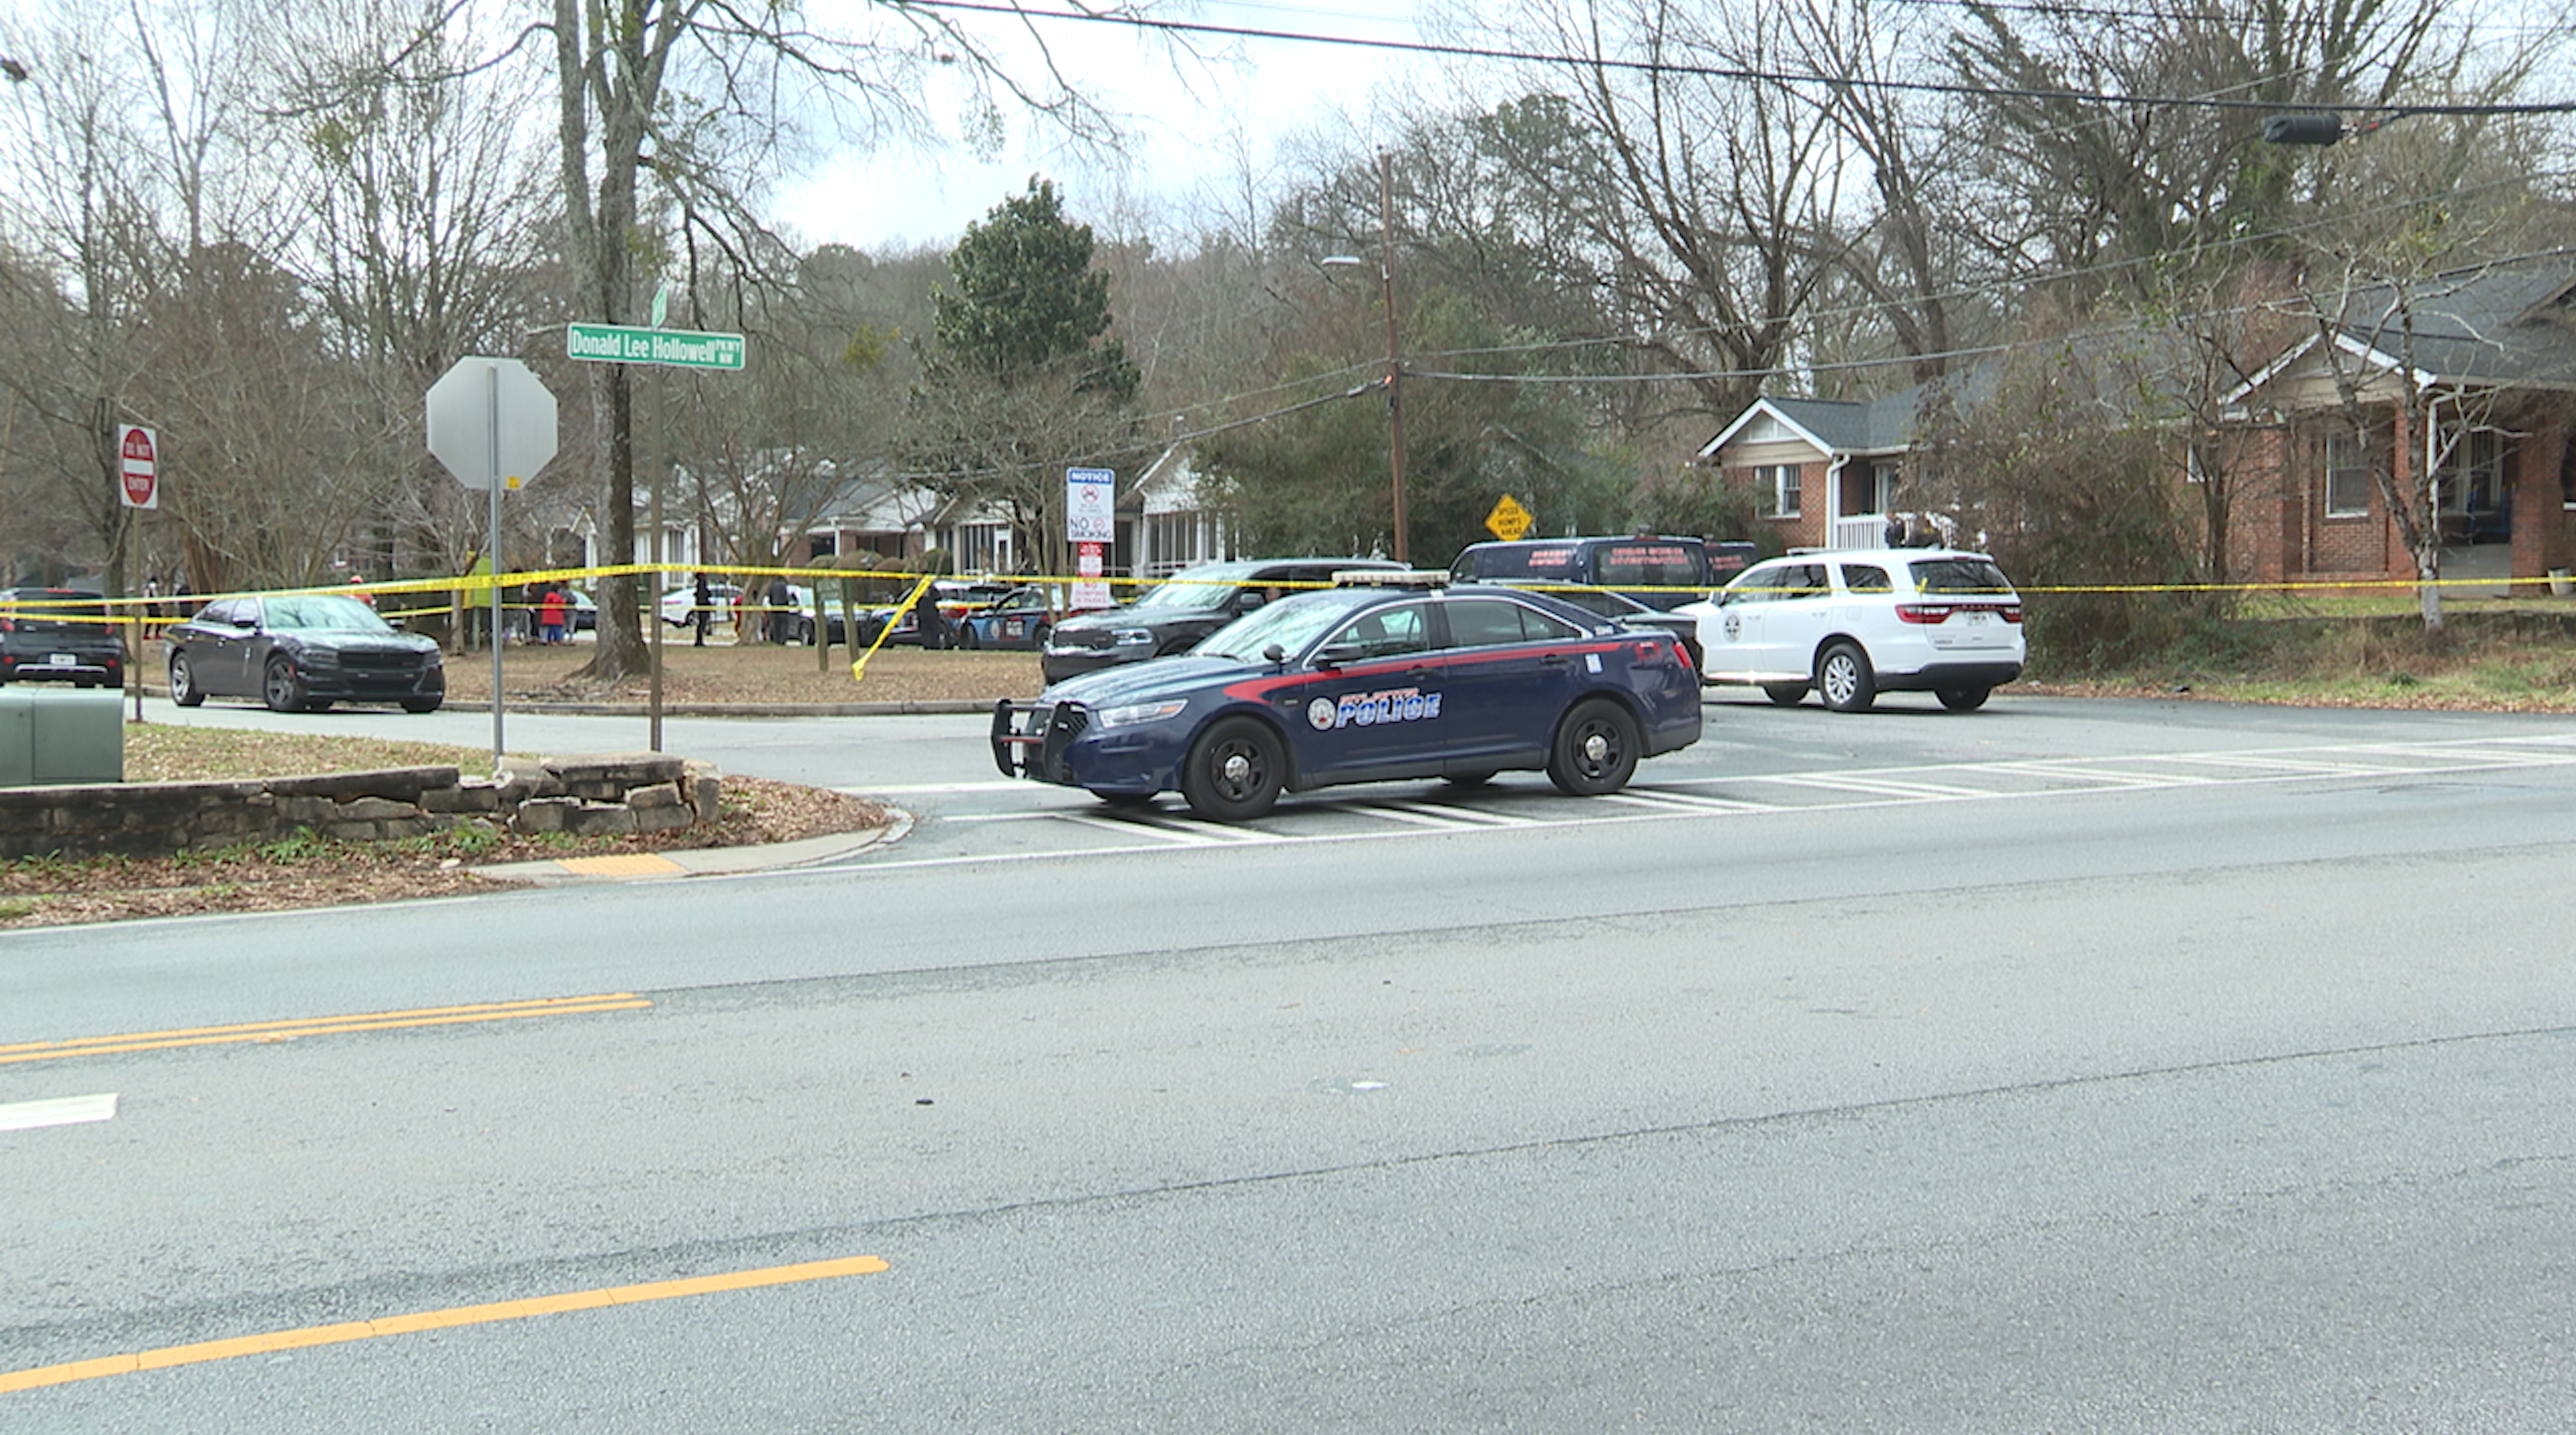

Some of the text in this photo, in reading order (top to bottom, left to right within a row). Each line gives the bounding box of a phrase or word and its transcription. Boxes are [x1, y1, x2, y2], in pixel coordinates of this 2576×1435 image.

[572, 329, 716, 362] Donald Lee Hollowell
[716, 338, 741, 352] PKWY
[719, 352, 735, 364] NW
[125, 442, 151, 458] DO NOT
[127, 476, 150, 492] ENTER
[1072, 472, 1111, 483] NOTICE
[1071, 517, 1089, 530] NO
[1071, 530, 1111, 539] SMOKING
[1335, 691, 1442, 729] POLICE
